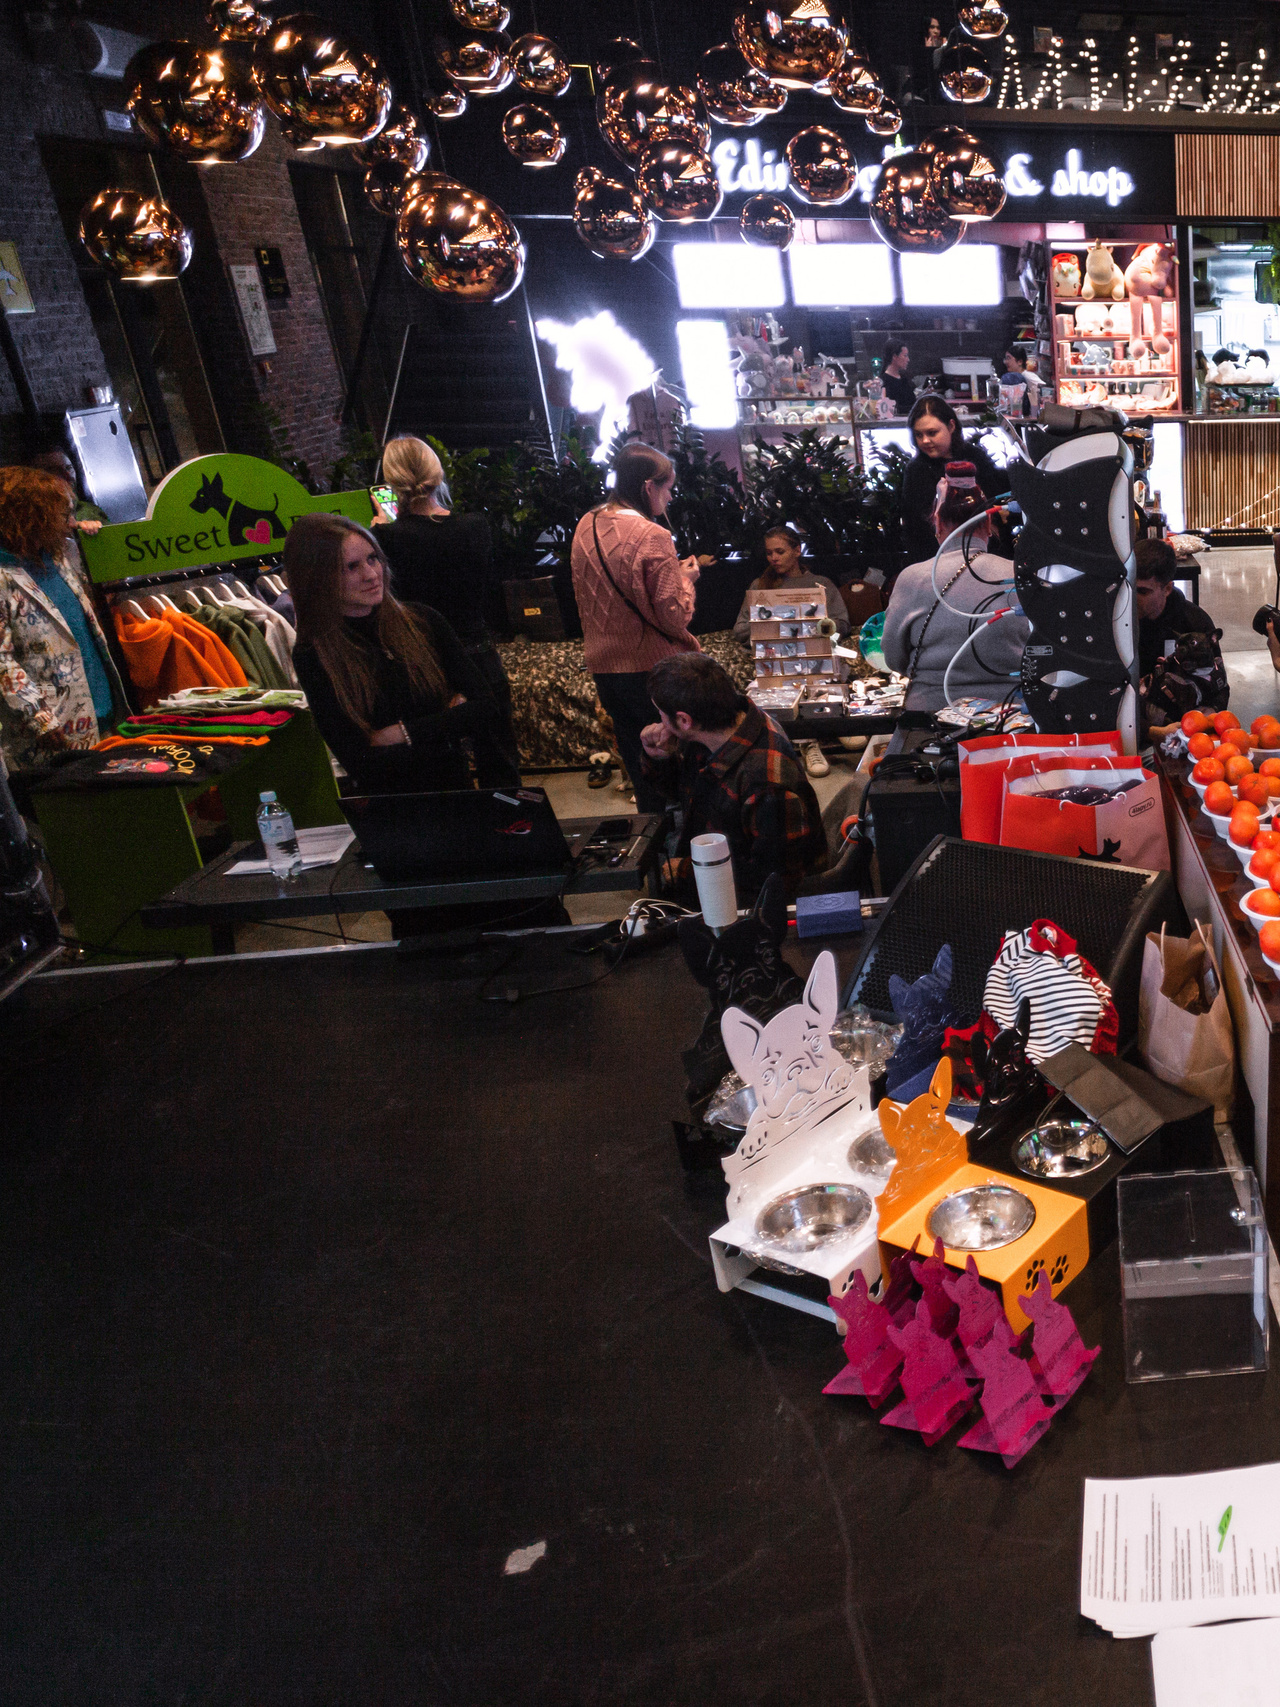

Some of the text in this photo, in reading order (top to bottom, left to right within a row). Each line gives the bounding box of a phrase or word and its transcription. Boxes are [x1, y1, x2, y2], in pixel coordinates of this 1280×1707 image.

[1004, 153, 1044, 196] &
[1051, 148, 1134, 207] shop
[124, 526, 227, 562] Sweet
